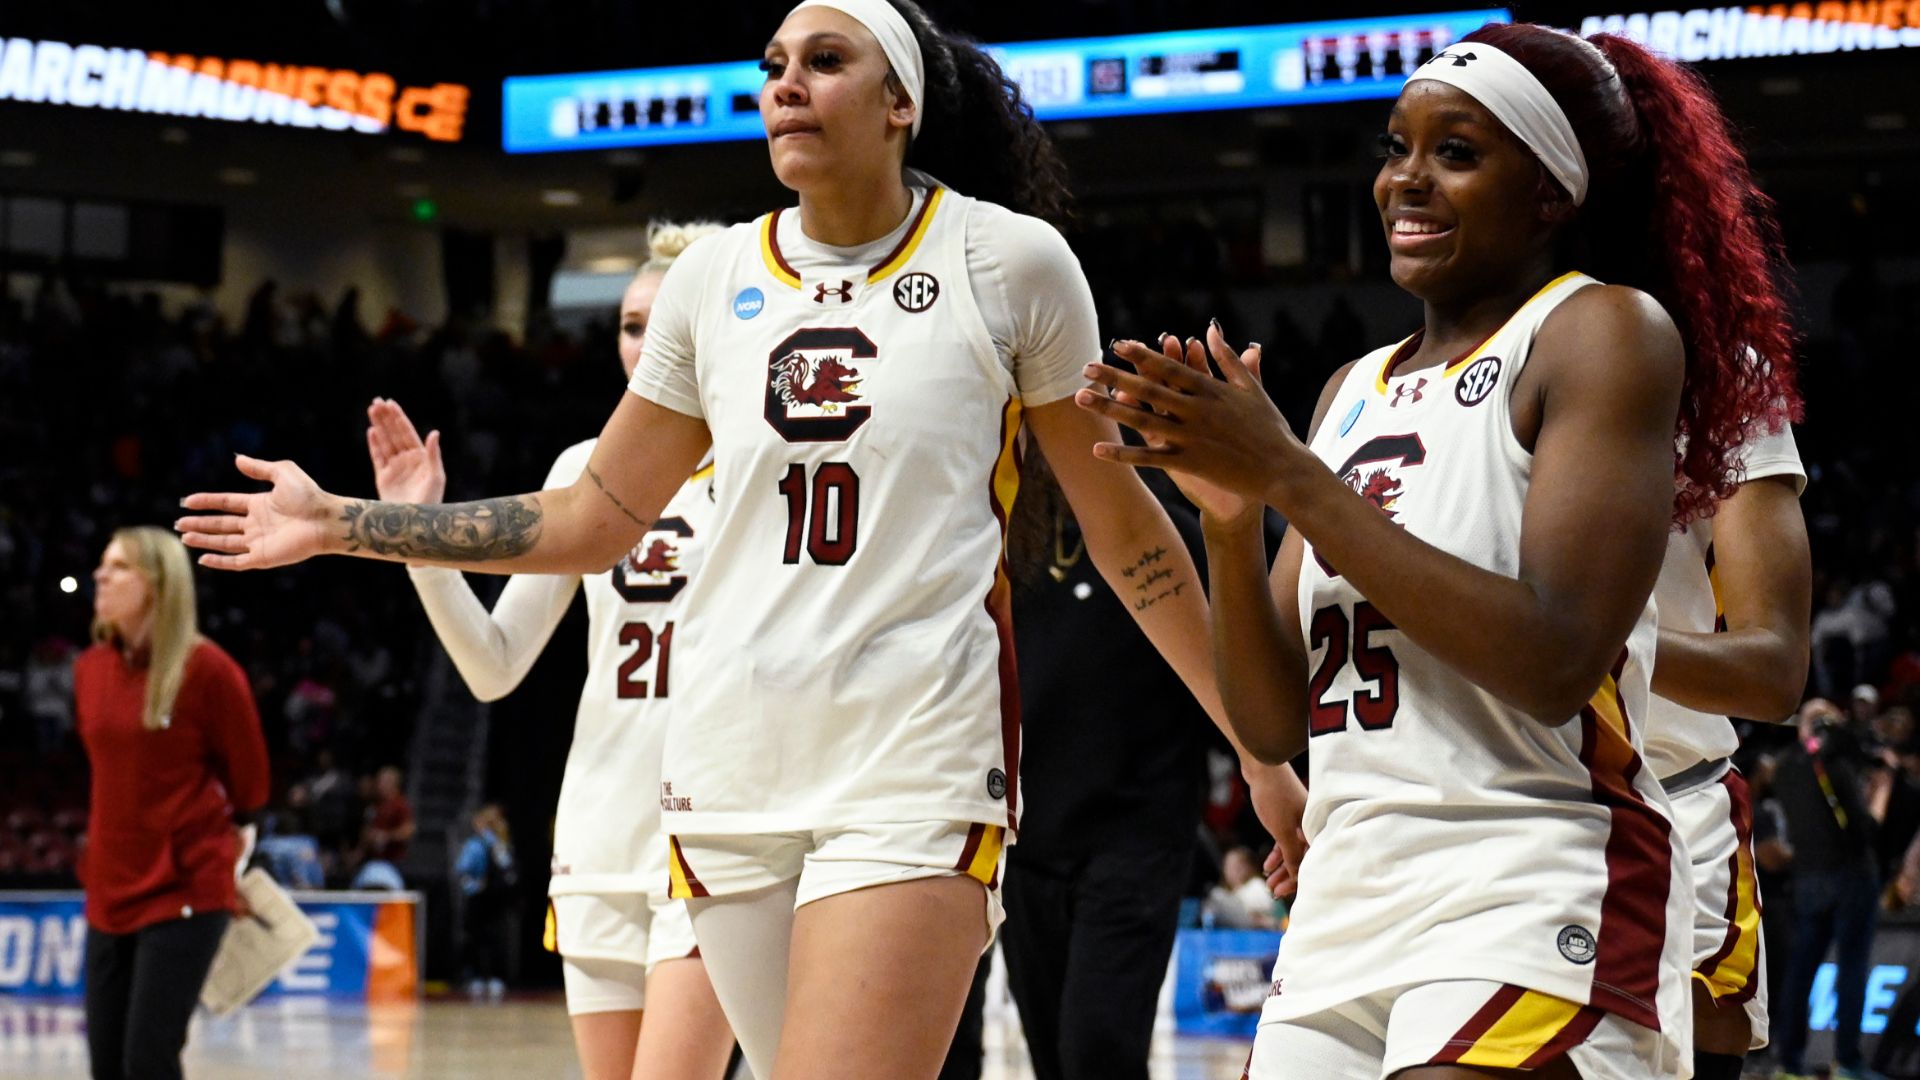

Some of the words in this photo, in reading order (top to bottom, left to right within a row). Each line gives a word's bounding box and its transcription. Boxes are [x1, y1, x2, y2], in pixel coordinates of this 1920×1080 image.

[896, 274, 935, 309] SEC
[1459, 359, 1499, 402] SEC
[778, 462, 860, 566] 10
[617, 621, 675, 699] 21
[1309, 600, 1400, 738] 25
